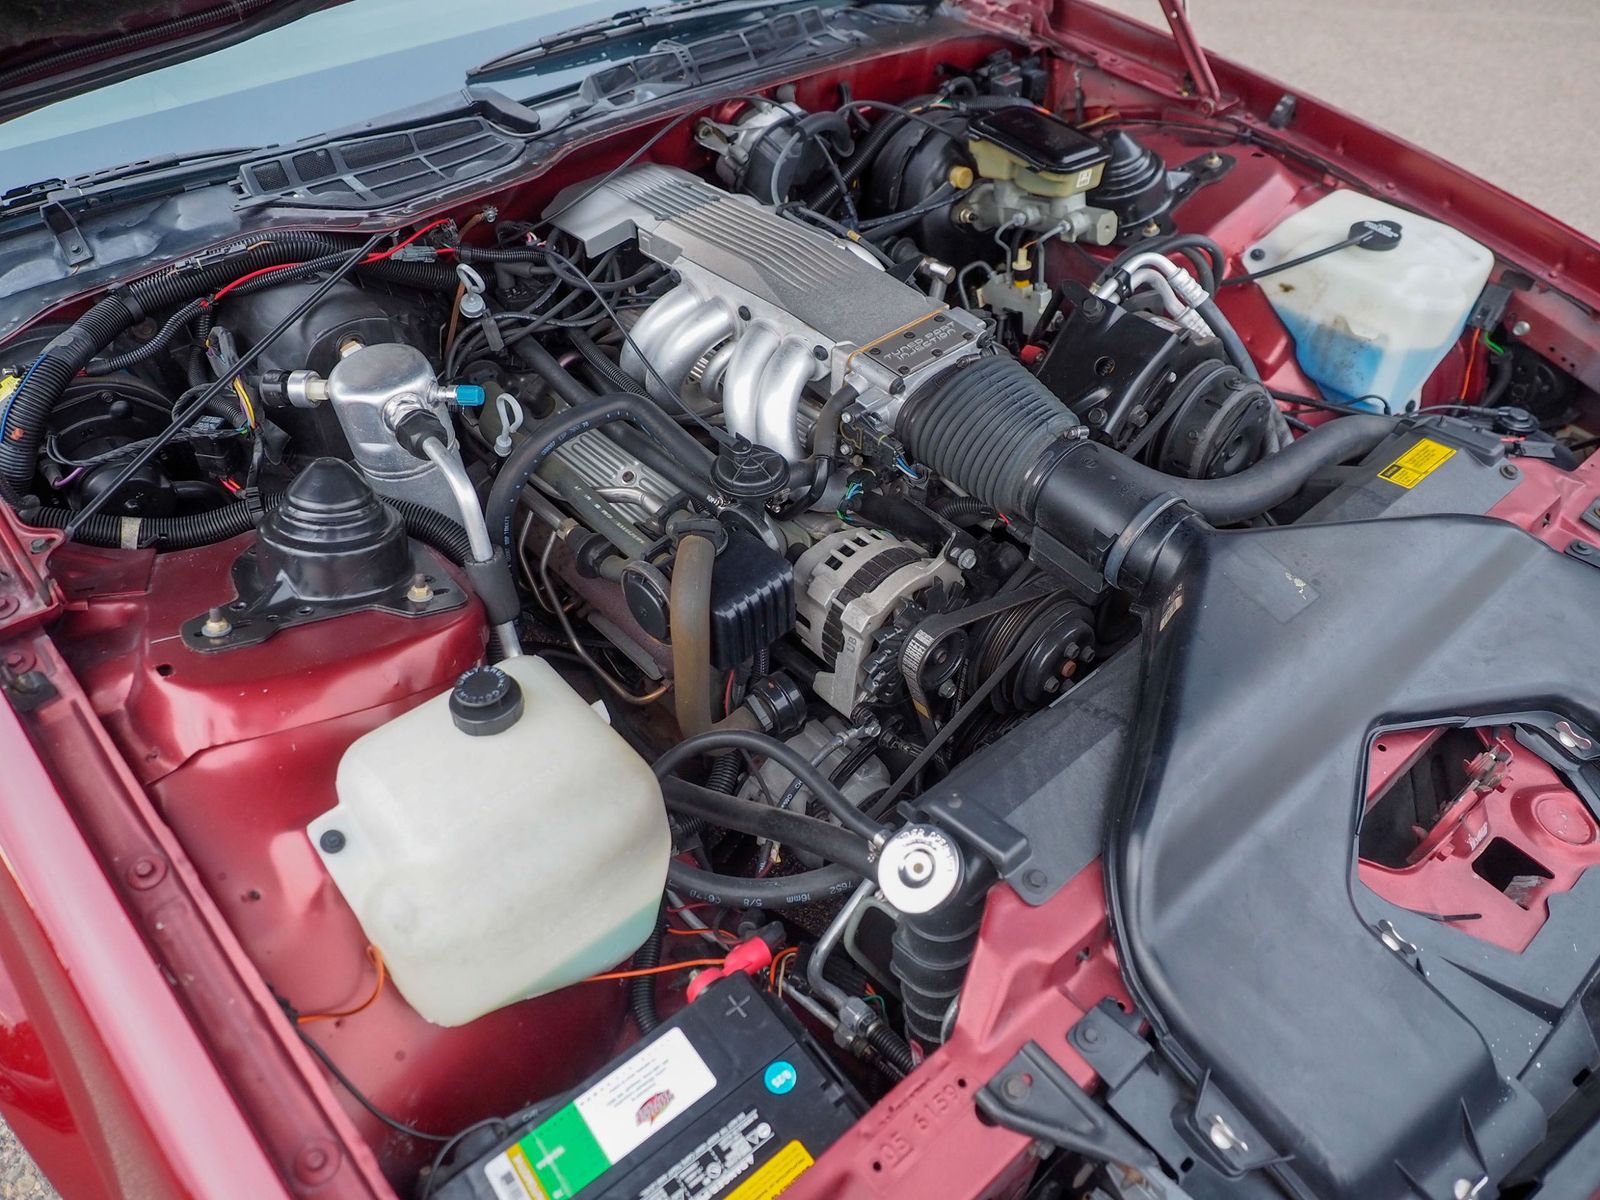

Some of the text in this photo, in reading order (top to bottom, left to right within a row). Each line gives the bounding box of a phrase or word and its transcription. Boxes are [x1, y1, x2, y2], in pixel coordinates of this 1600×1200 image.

[883, 320, 955, 360] TUNED PORT
[897, 327, 957, 361] INJECTION
[743, 898, 763, 907] 5/8
[786, 893, 812, 904] 16mm
